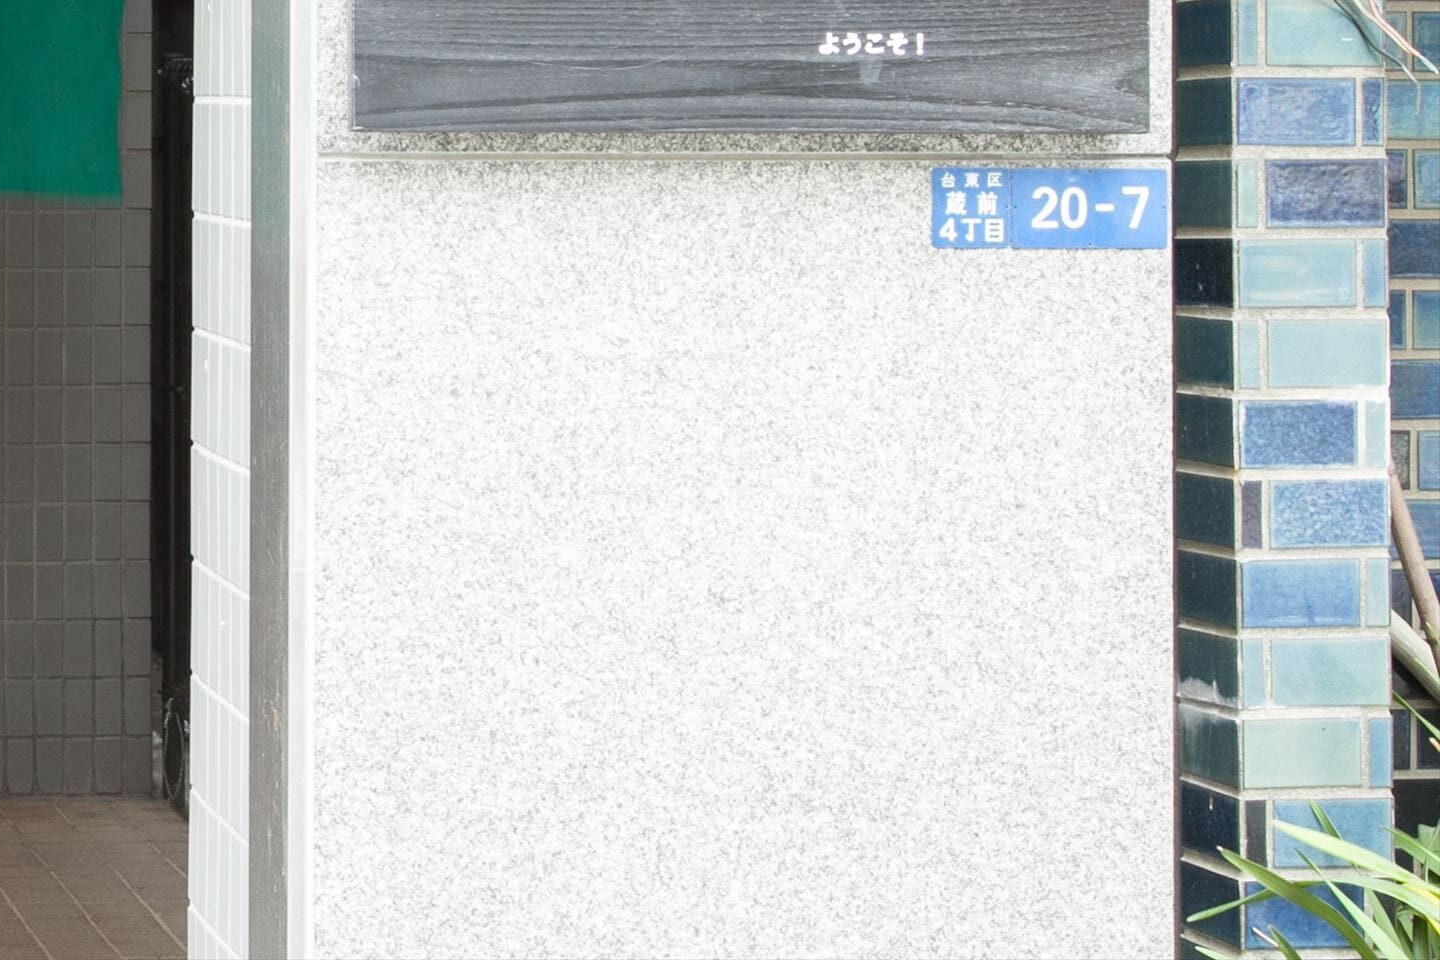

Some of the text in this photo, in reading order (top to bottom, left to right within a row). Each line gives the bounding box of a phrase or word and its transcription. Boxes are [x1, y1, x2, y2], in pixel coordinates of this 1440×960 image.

[940, 172, 1002, 188] 台東区
[945, 191, 998, 216] 蔵前
[1031, 186, 1150, 229] 20-7
[939, 218, 1004, 243] 4丁目
